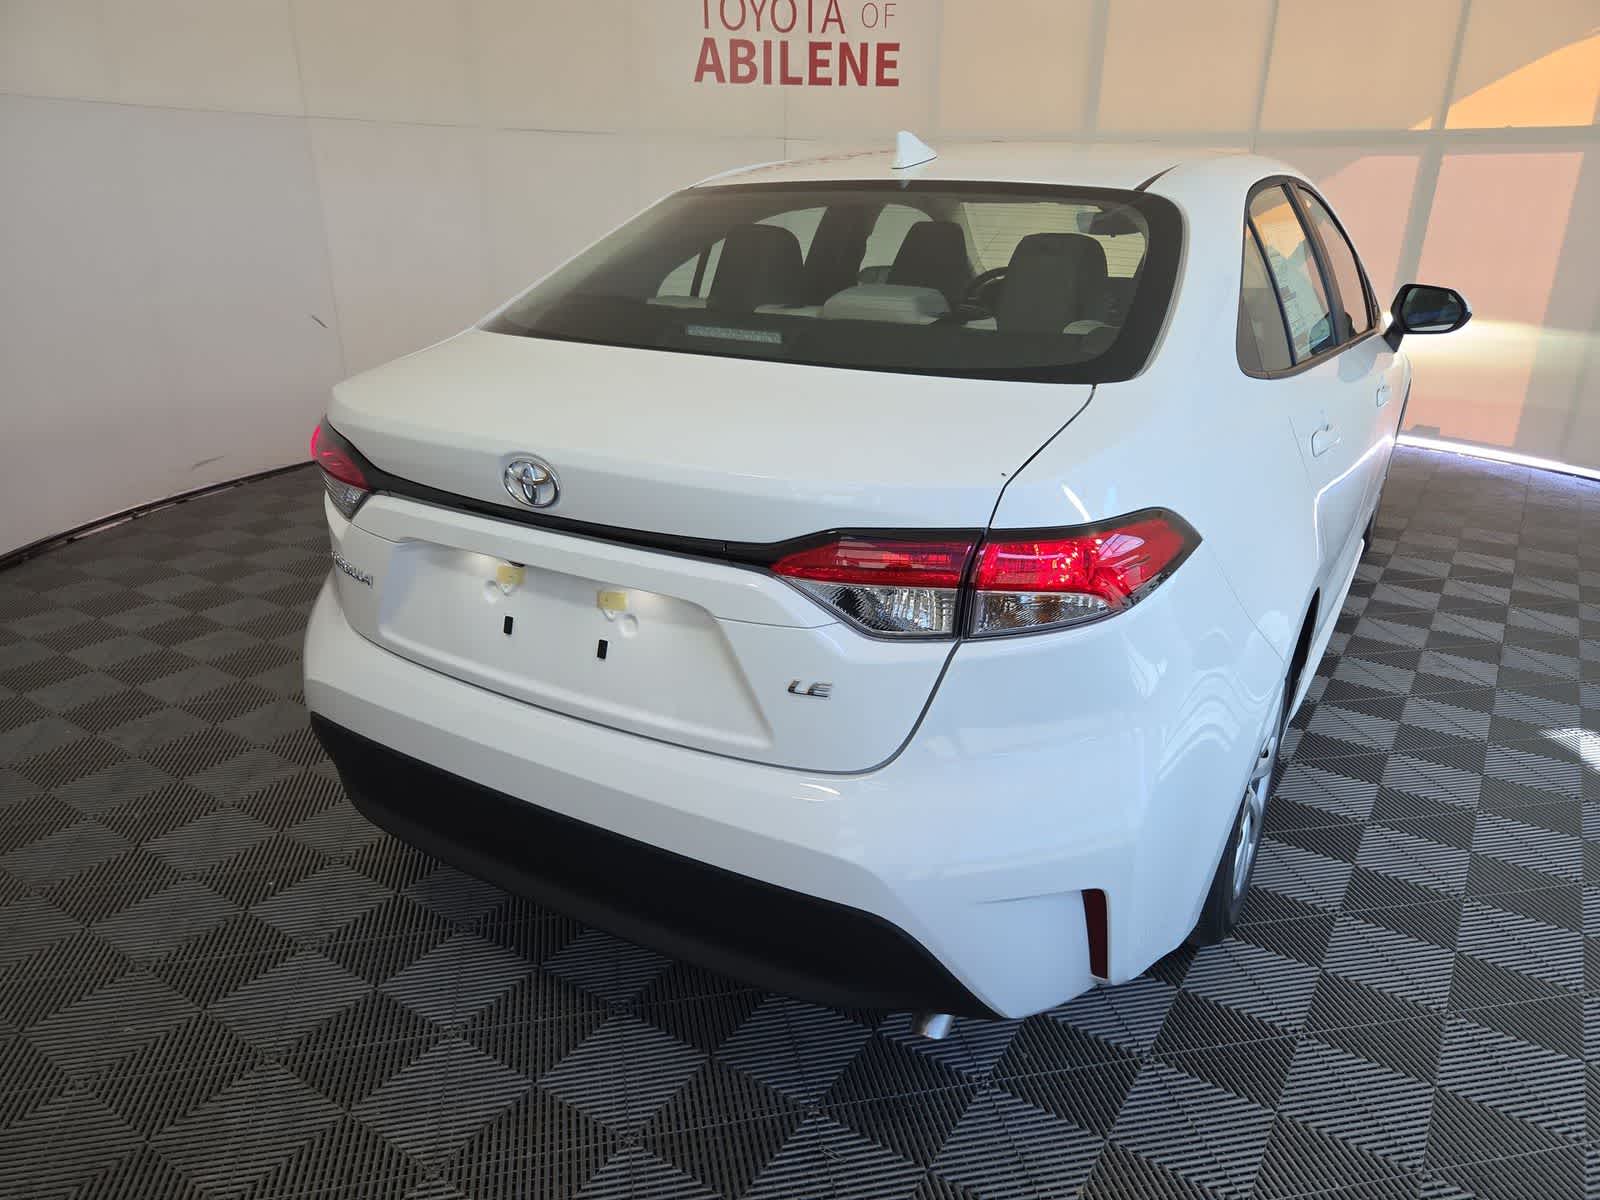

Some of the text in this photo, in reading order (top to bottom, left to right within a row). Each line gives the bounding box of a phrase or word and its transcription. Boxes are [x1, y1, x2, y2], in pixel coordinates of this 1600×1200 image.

[861, 2, 896, 29] OF
[694, 37, 900, 87] ABILENE
[787, 679, 832, 700] LE
